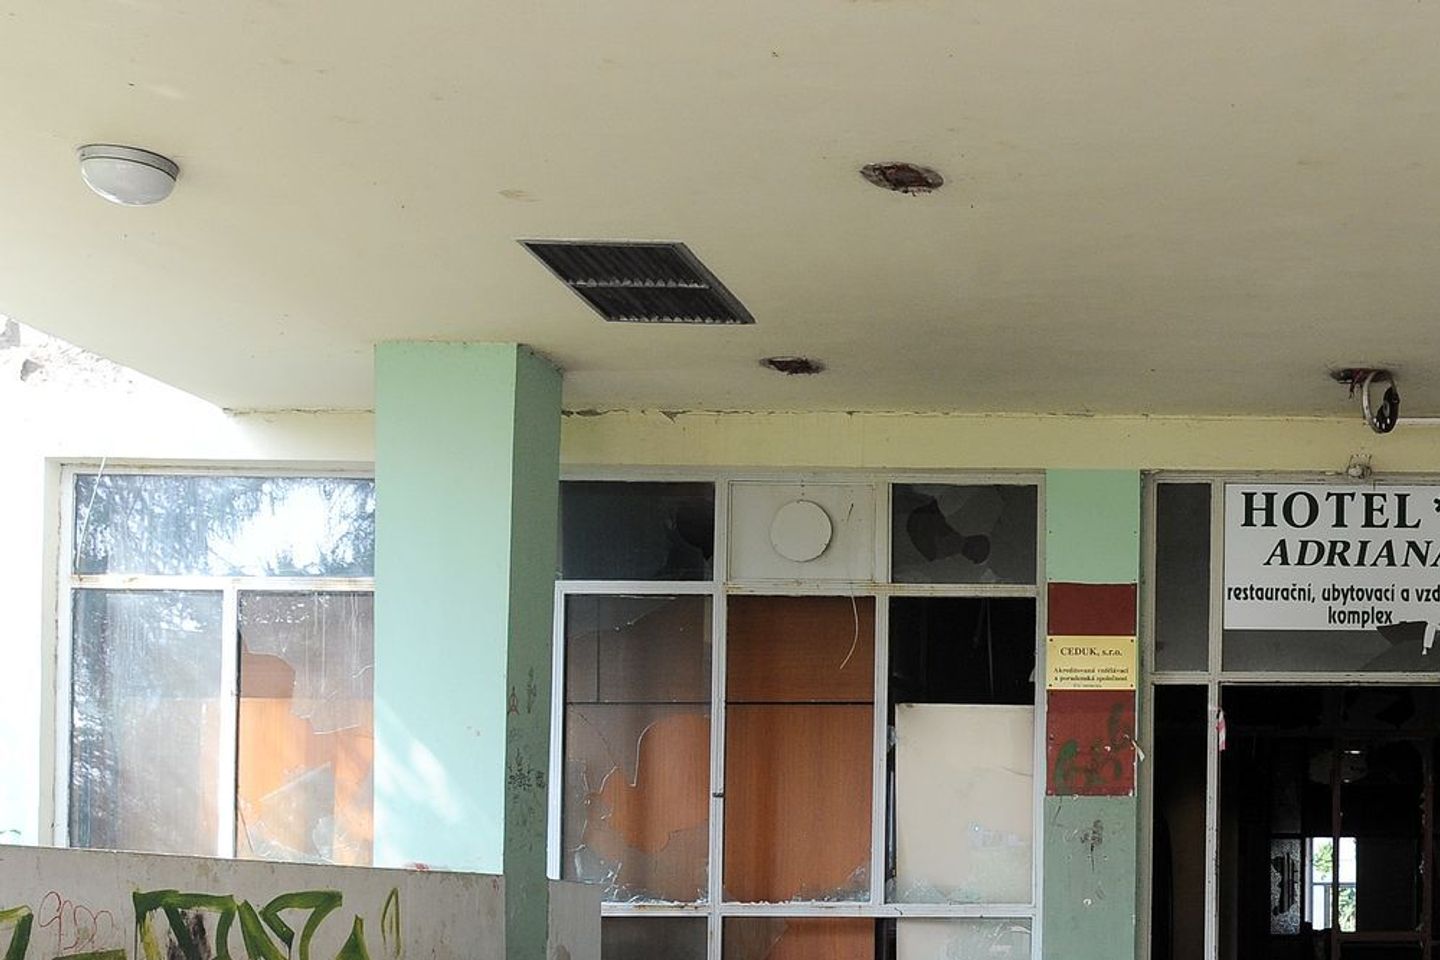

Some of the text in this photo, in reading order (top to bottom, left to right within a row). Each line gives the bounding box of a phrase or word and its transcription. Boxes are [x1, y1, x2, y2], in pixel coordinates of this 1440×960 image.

[1240, 491, 1422, 529] HOTEL
[1227, 583, 1316, 603] restaurační,
[1321, 583, 1396, 606] ubytovací
[1400, 587, 1410, 602] a
[1328, 606, 1393, 629] komplex
